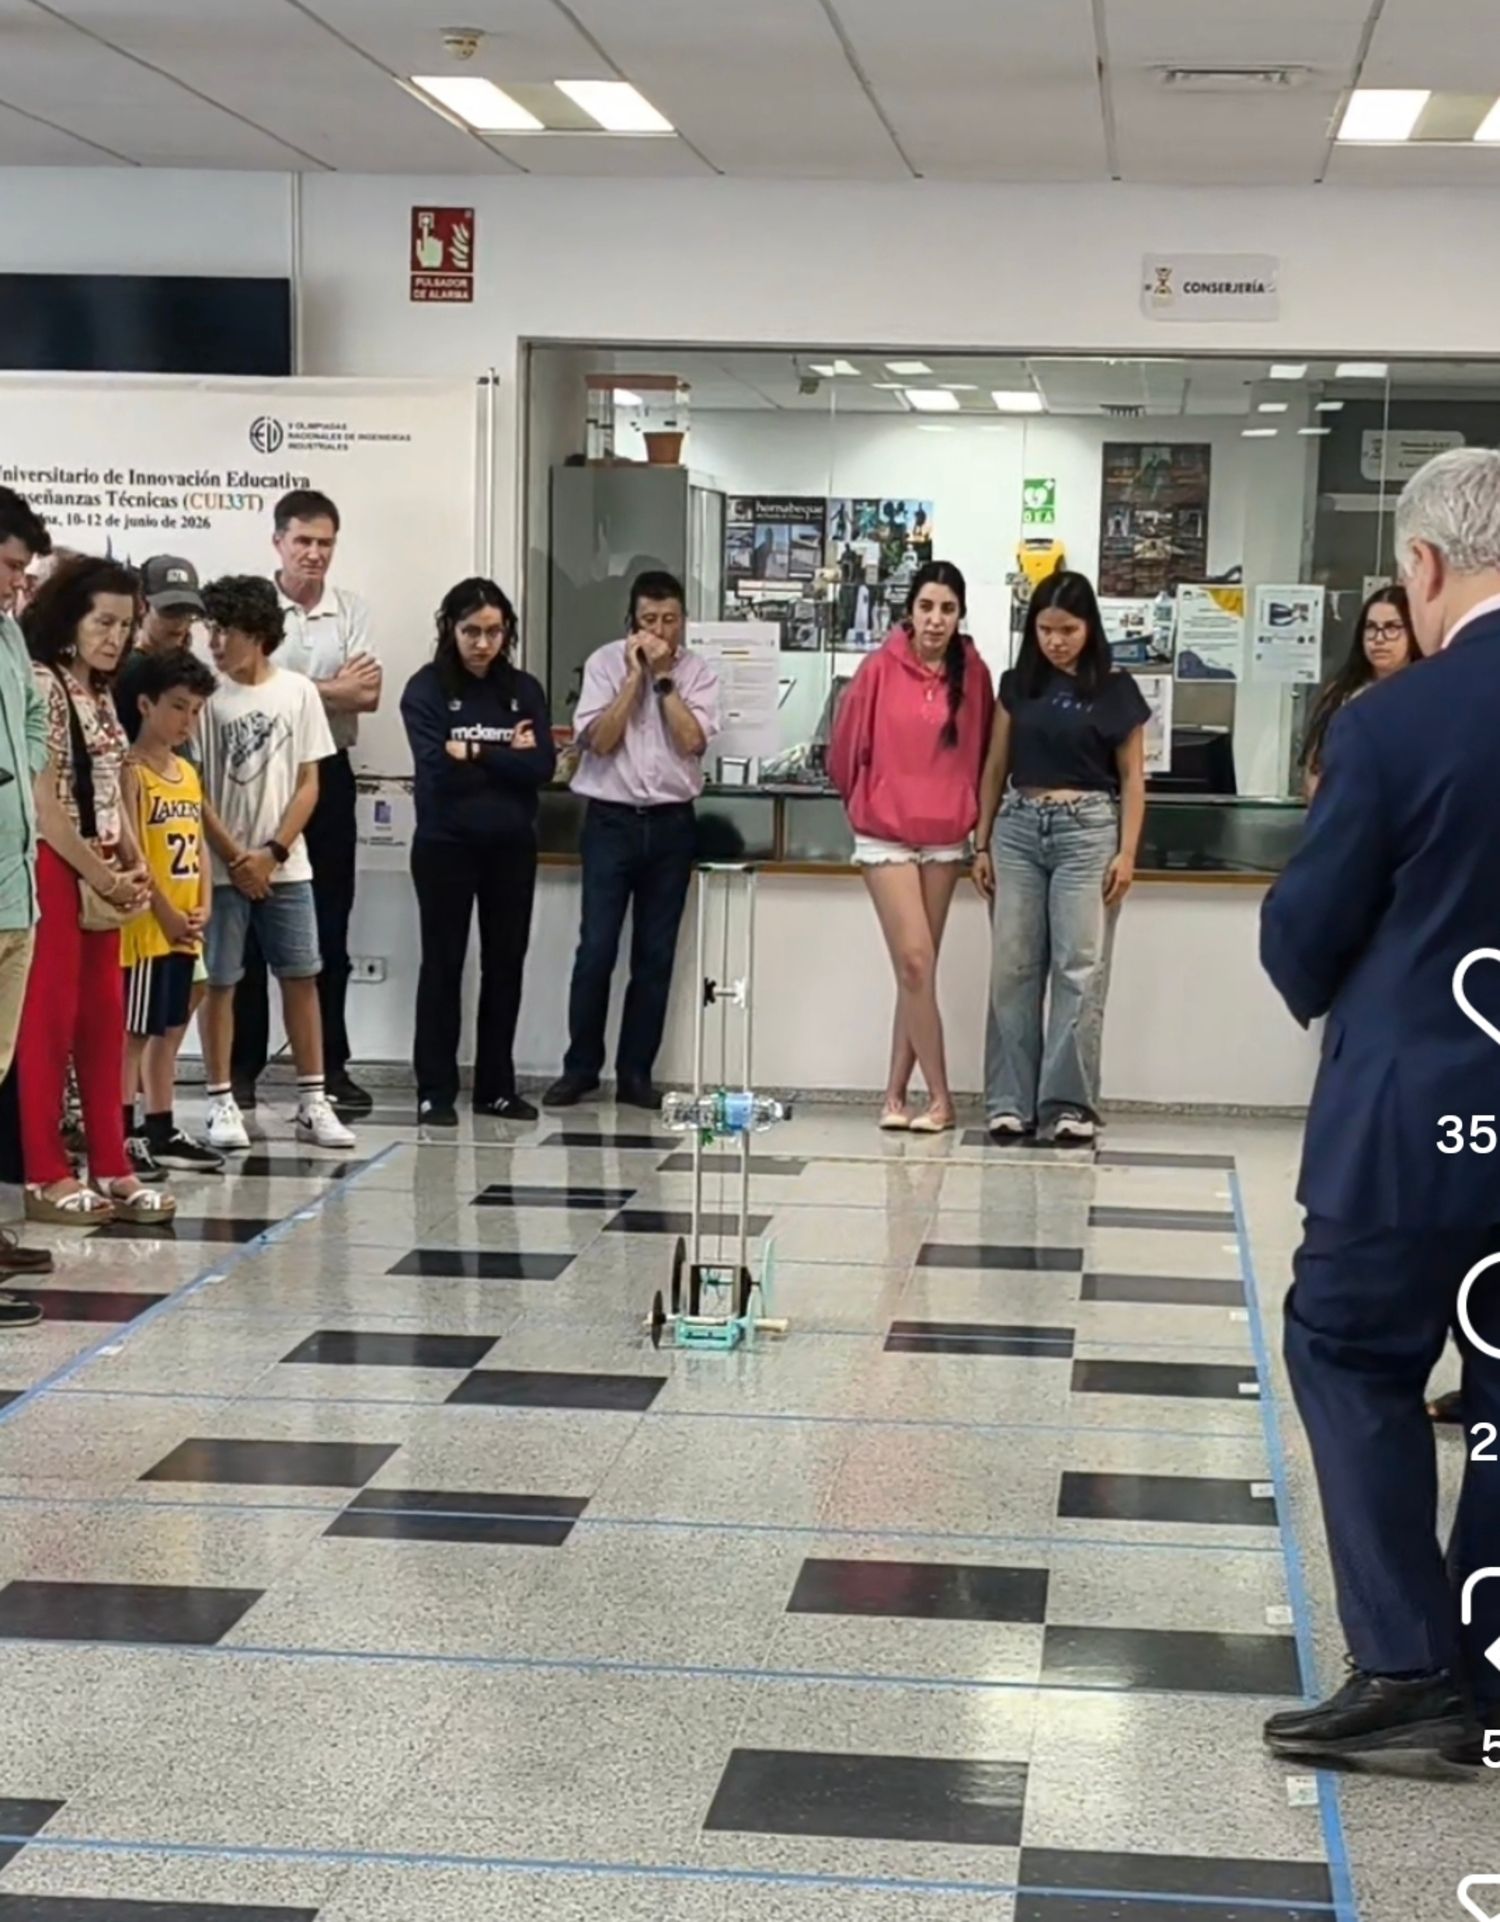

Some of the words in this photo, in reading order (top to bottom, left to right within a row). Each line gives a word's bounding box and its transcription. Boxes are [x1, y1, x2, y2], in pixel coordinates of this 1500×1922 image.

[414, 289, 426, 299] DE
[429, 289, 469, 299] ALARMA
[1183, 279, 1265, 294] CONSERJERÍA
[103, 469, 124, 486] de
[129, 469, 221, 488] Innovación
[227, 471, 310, 489] Educativa
[105, 489, 179, 509] Técnicas
[66, 512, 102, 527] 10-12
[105, 513, 121, 528] de
[123, 514, 159, 531] junio
[161, 515, 177, 529] de
[181, 515, 212, 530] 2026
